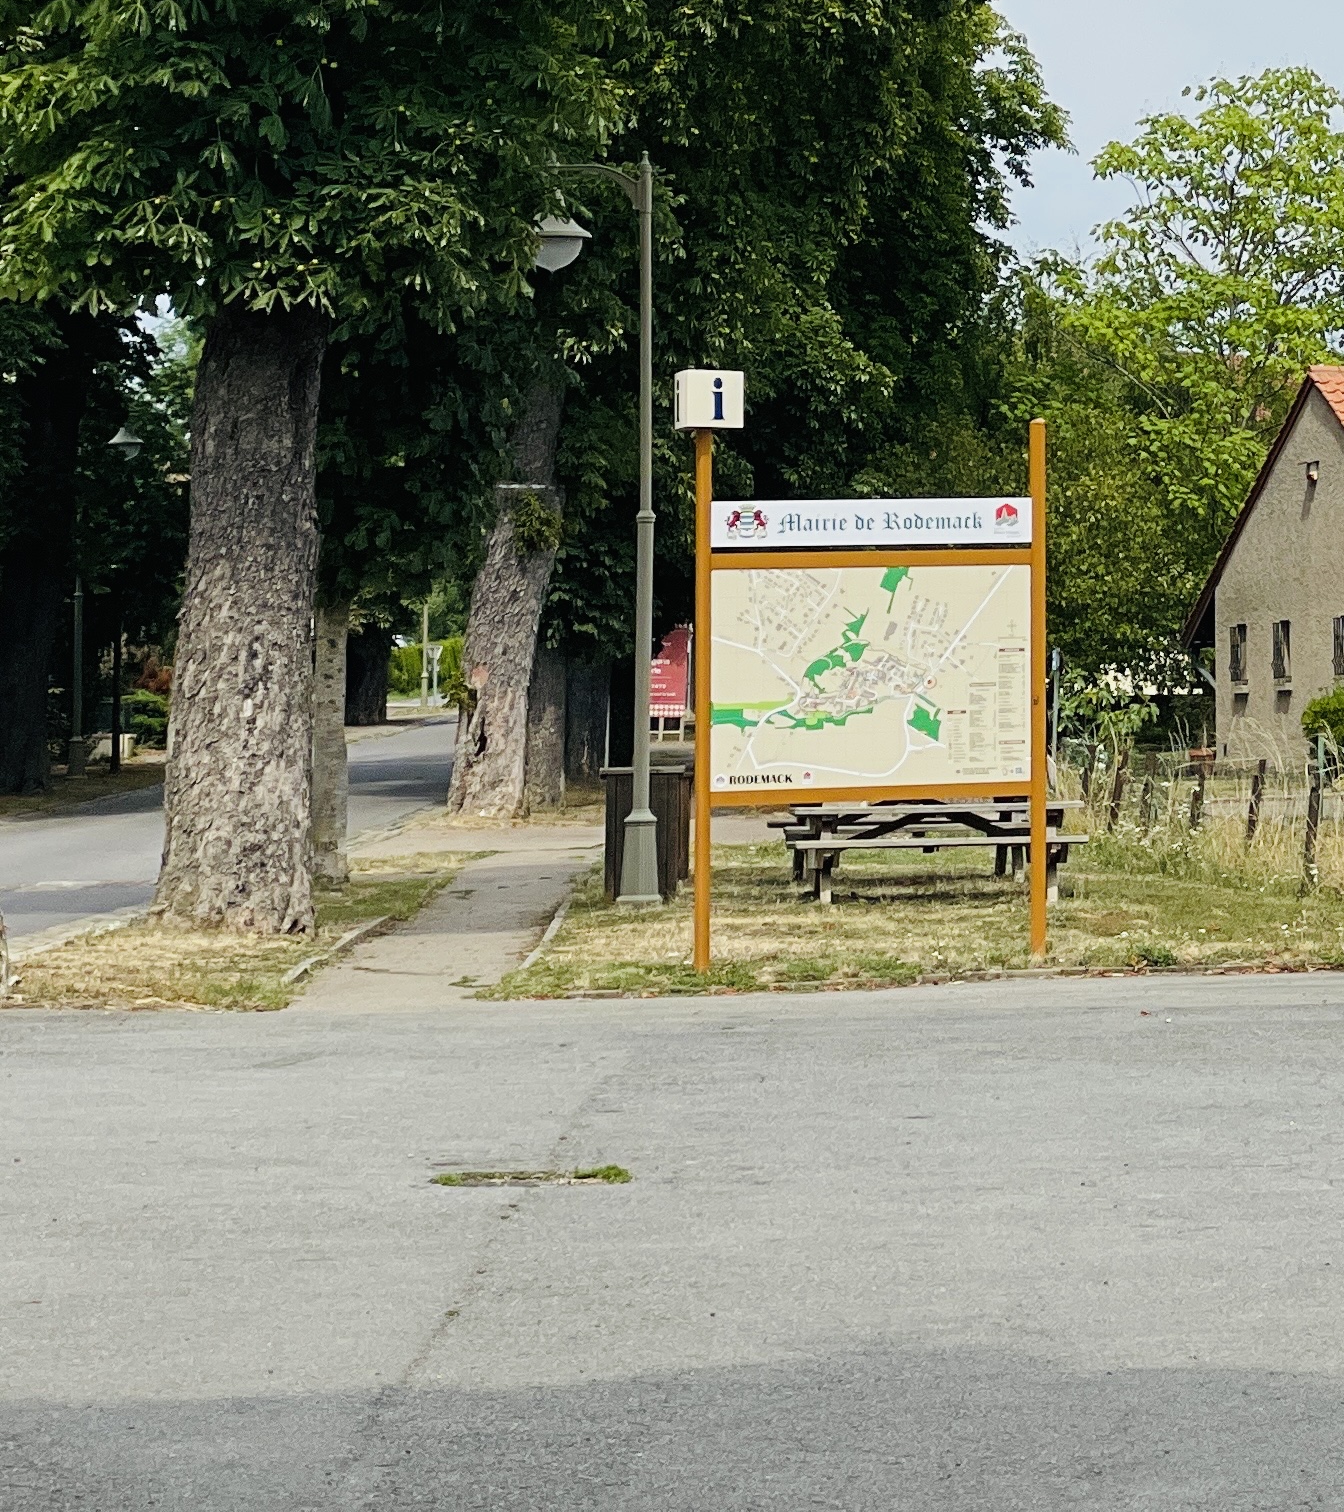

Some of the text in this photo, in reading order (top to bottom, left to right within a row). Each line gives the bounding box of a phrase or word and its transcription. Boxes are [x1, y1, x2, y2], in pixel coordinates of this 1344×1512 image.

[711, 377, 726, 420] i
[776, 511, 983, 534] Mairie de Rodemack
[729, 774, 793, 785] RODEMACK
